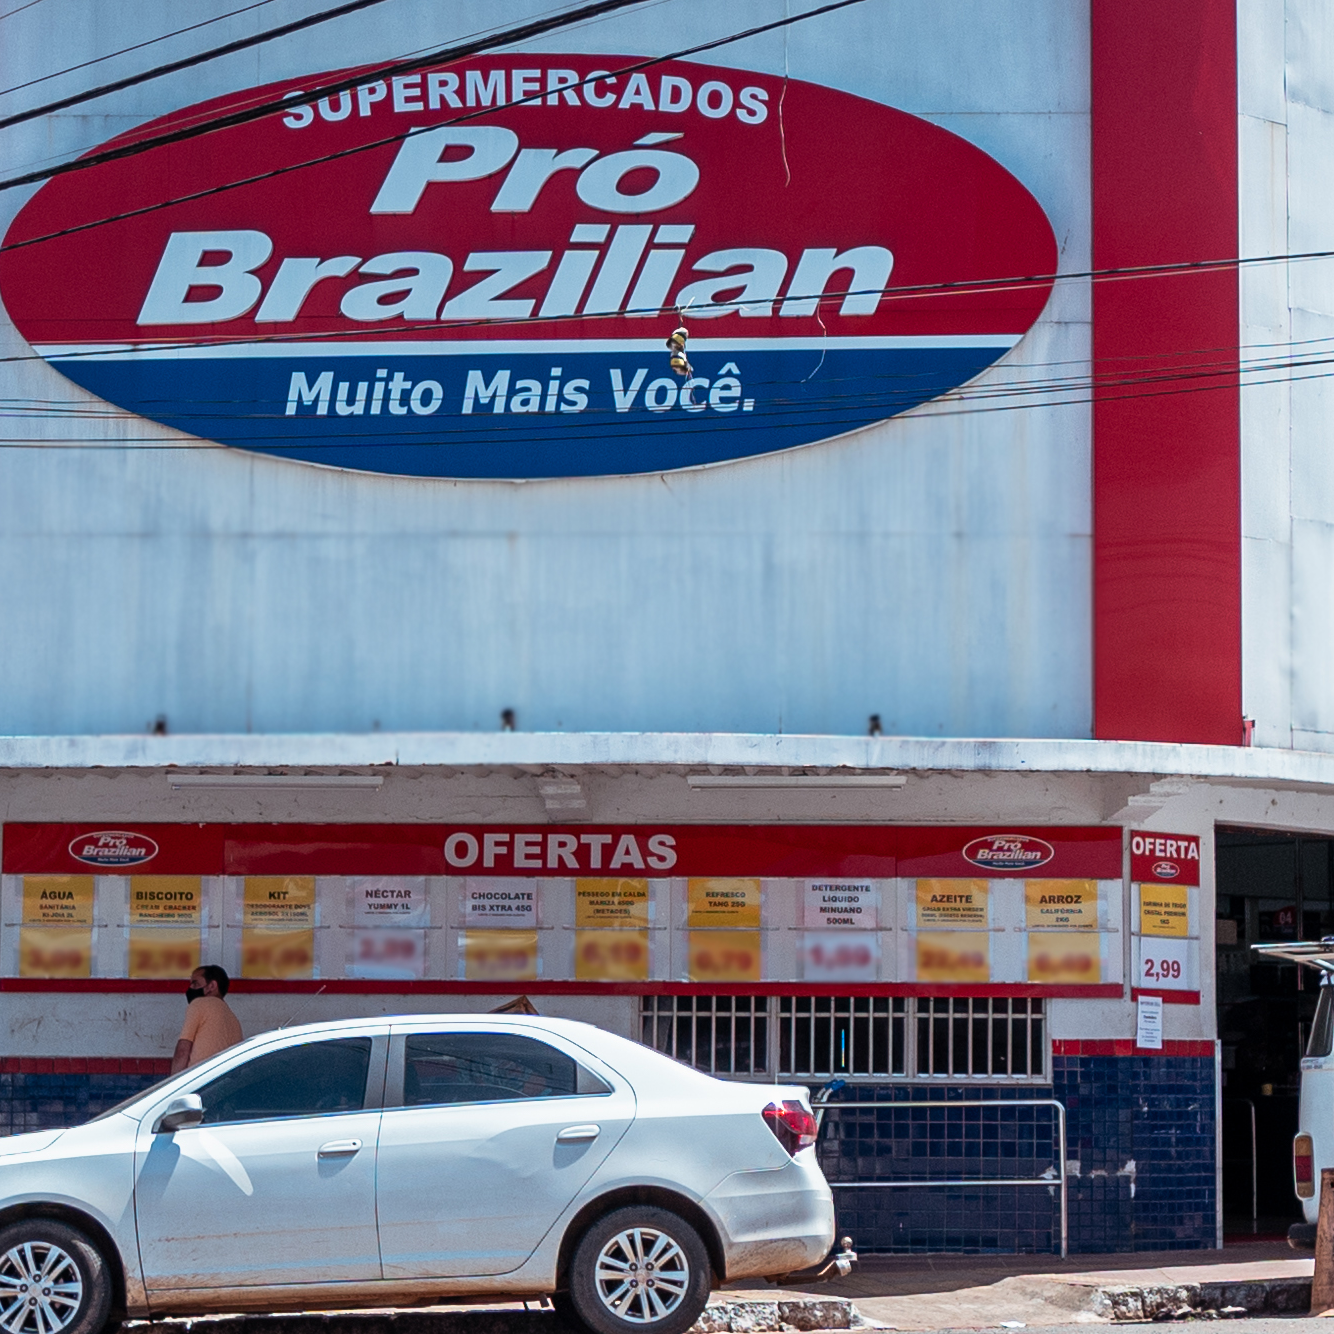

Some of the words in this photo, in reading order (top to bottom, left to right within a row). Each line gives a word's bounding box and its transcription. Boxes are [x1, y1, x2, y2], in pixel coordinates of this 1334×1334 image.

[281, 67, 769, 130] SUPERMERCADOS
[369, 126, 700, 216] Pró
[135, 224, 894, 326] Brazilian
[285, 369, 443, 418] Muito
[461, 368, 590, 415] Mais
[608, 362, 756, 414] Você.
[97, 835, 127, 847] Pró
[992, 839, 1022, 851] Pró
[82, 845, 146, 856] Brazilian
[443, 832, 678, 870] OFERTAS
[1132, 836, 1200, 860] OFERTA
[976, 849, 1042, 860] Brazilian
[365, 888, 412, 900] NÉCTAR
[811, 884, 871, 893] DETERGENTE
[40, 888, 75, 901] ÁGUA
[135, 891, 194, 902] BISCOITO
[268, 890, 289, 901] KIT
[471, 891, 534, 901] CHOCOLATE
[822, 893, 860, 903] LÍQUIDO
[930, 894, 973, 904] AZEITE
[1039, 895, 1082, 905] ARROZ
[39, 902, 77, 911] SANITÁRIA
[367, 902, 399, 911] YUMMY
[400, 902, 411, 911] 1L
[471, 903, 487, 912] BIS
[488, 904, 513, 913] XTRA
[514, 904, 533, 913] 45G
[819, 905, 863, 915] MINUANO
[826, 917, 855, 926] 500ML
[1279, 911, 1293, 925] 04
[1144, 958, 1181, 982] 2,99
